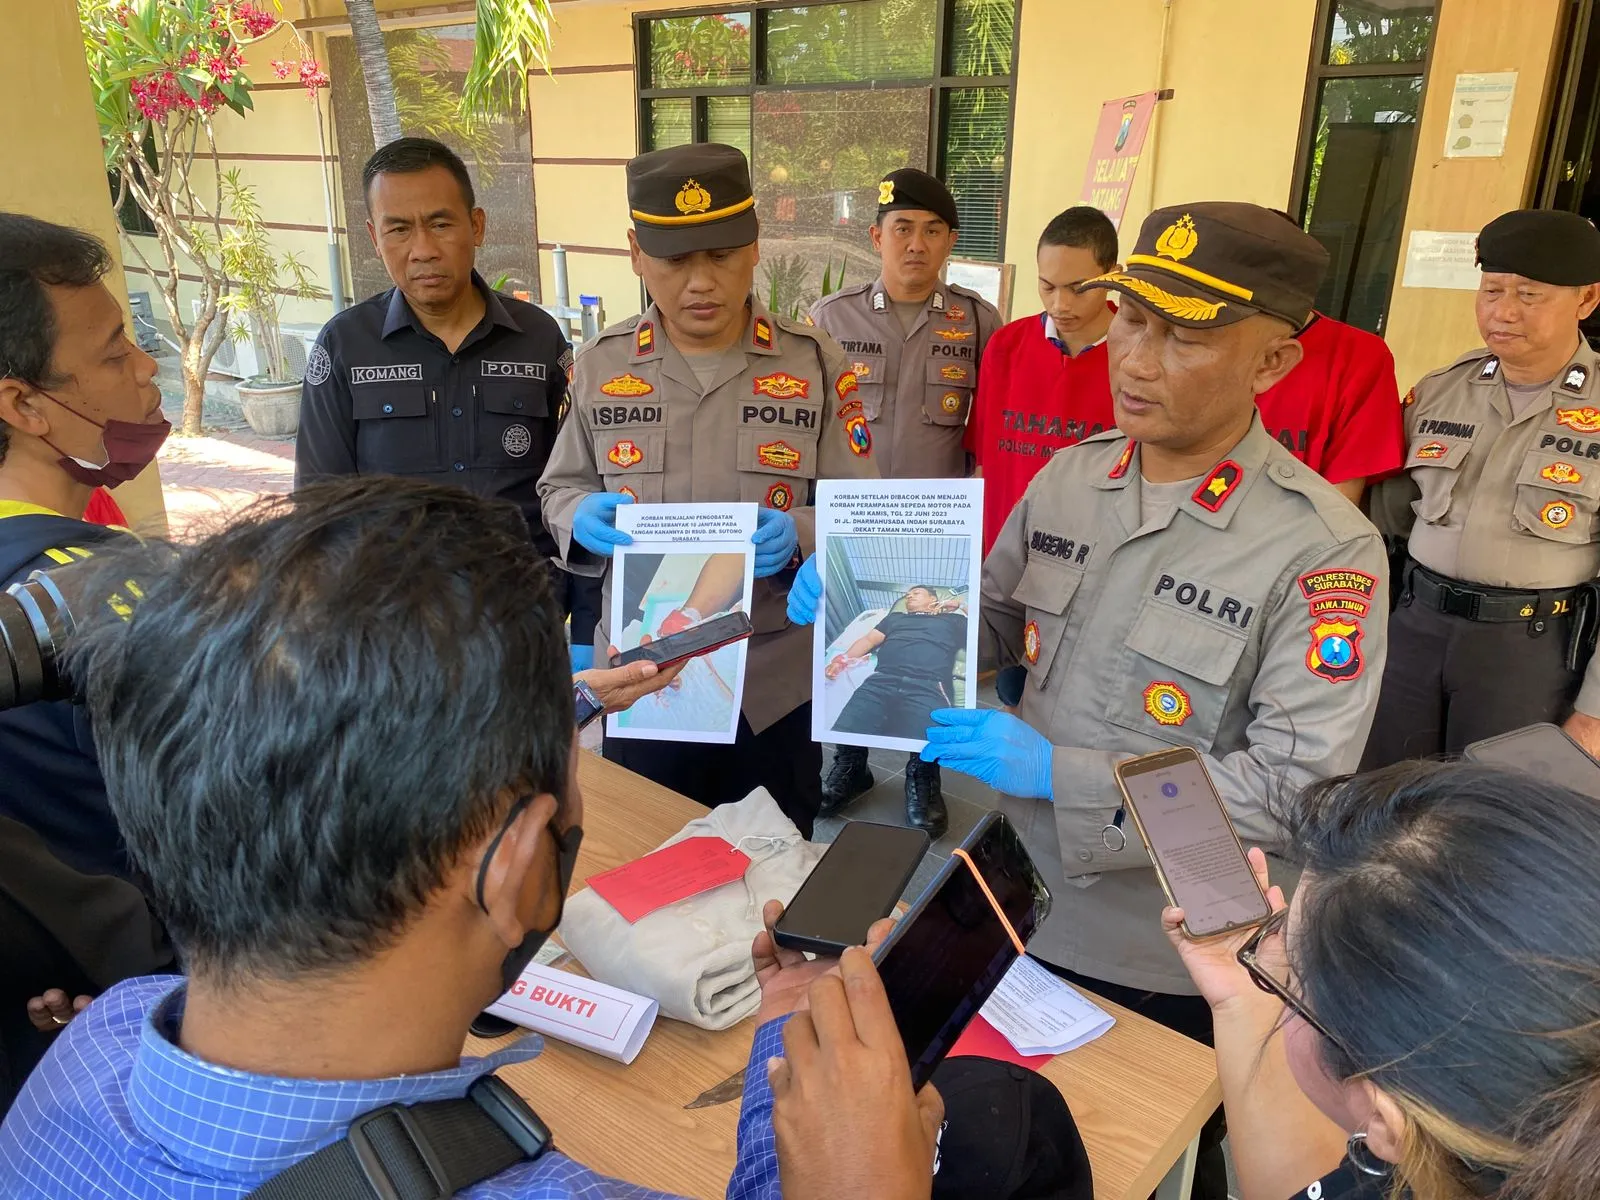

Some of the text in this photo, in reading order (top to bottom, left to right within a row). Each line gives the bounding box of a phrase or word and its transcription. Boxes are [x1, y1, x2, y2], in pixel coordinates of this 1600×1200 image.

[841, 341, 882, 354] TIRTANA
[931, 344, 972, 358] POLRI
[356, 367, 418, 381] KOMANG
[487, 363, 540, 377] POLRI
[593, 406, 662, 425] ISBADI
[743, 405, 817, 428] POLRI
[1002, 409, 1118, 440] TAHANA
[1031, 530, 1090, 565] SUGENG R
[1306, 572, 1372, 587] POLRESTABES
[1314, 581, 1365, 592] SURABAYA
[1154, 574, 1253, 628] POLRI
[1315, 600, 1365, 614] JAWA TIMUR
[529, 985, 597, 1018] BUKTI
